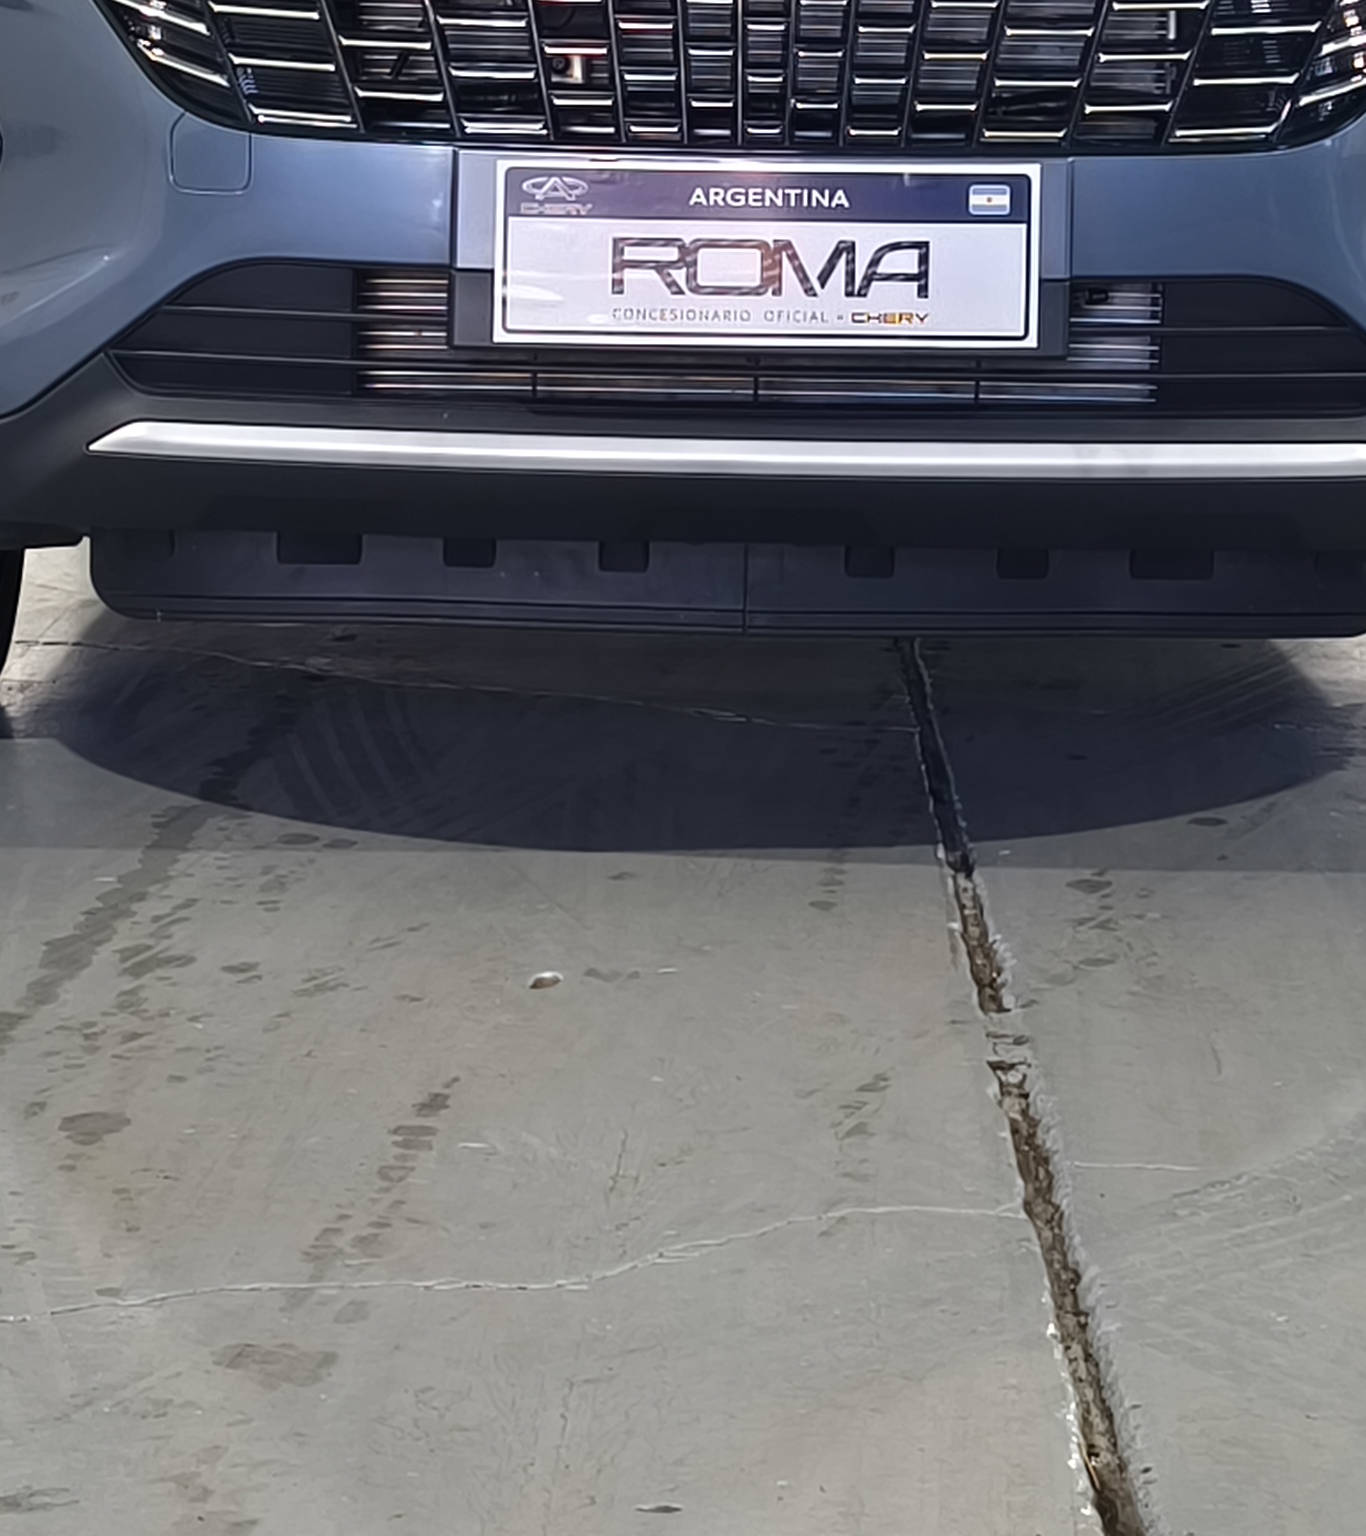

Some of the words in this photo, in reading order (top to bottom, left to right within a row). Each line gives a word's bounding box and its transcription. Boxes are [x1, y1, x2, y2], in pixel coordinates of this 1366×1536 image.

[689, 187, 851, 208] ARGENTINA
[611, 237, 930, 299] ROMA
[612, 308, 751, 322] CONCESIONARIO
[764, 310, 829, 324] OFICIAL
[851, 312, 929, 324] CHERY
